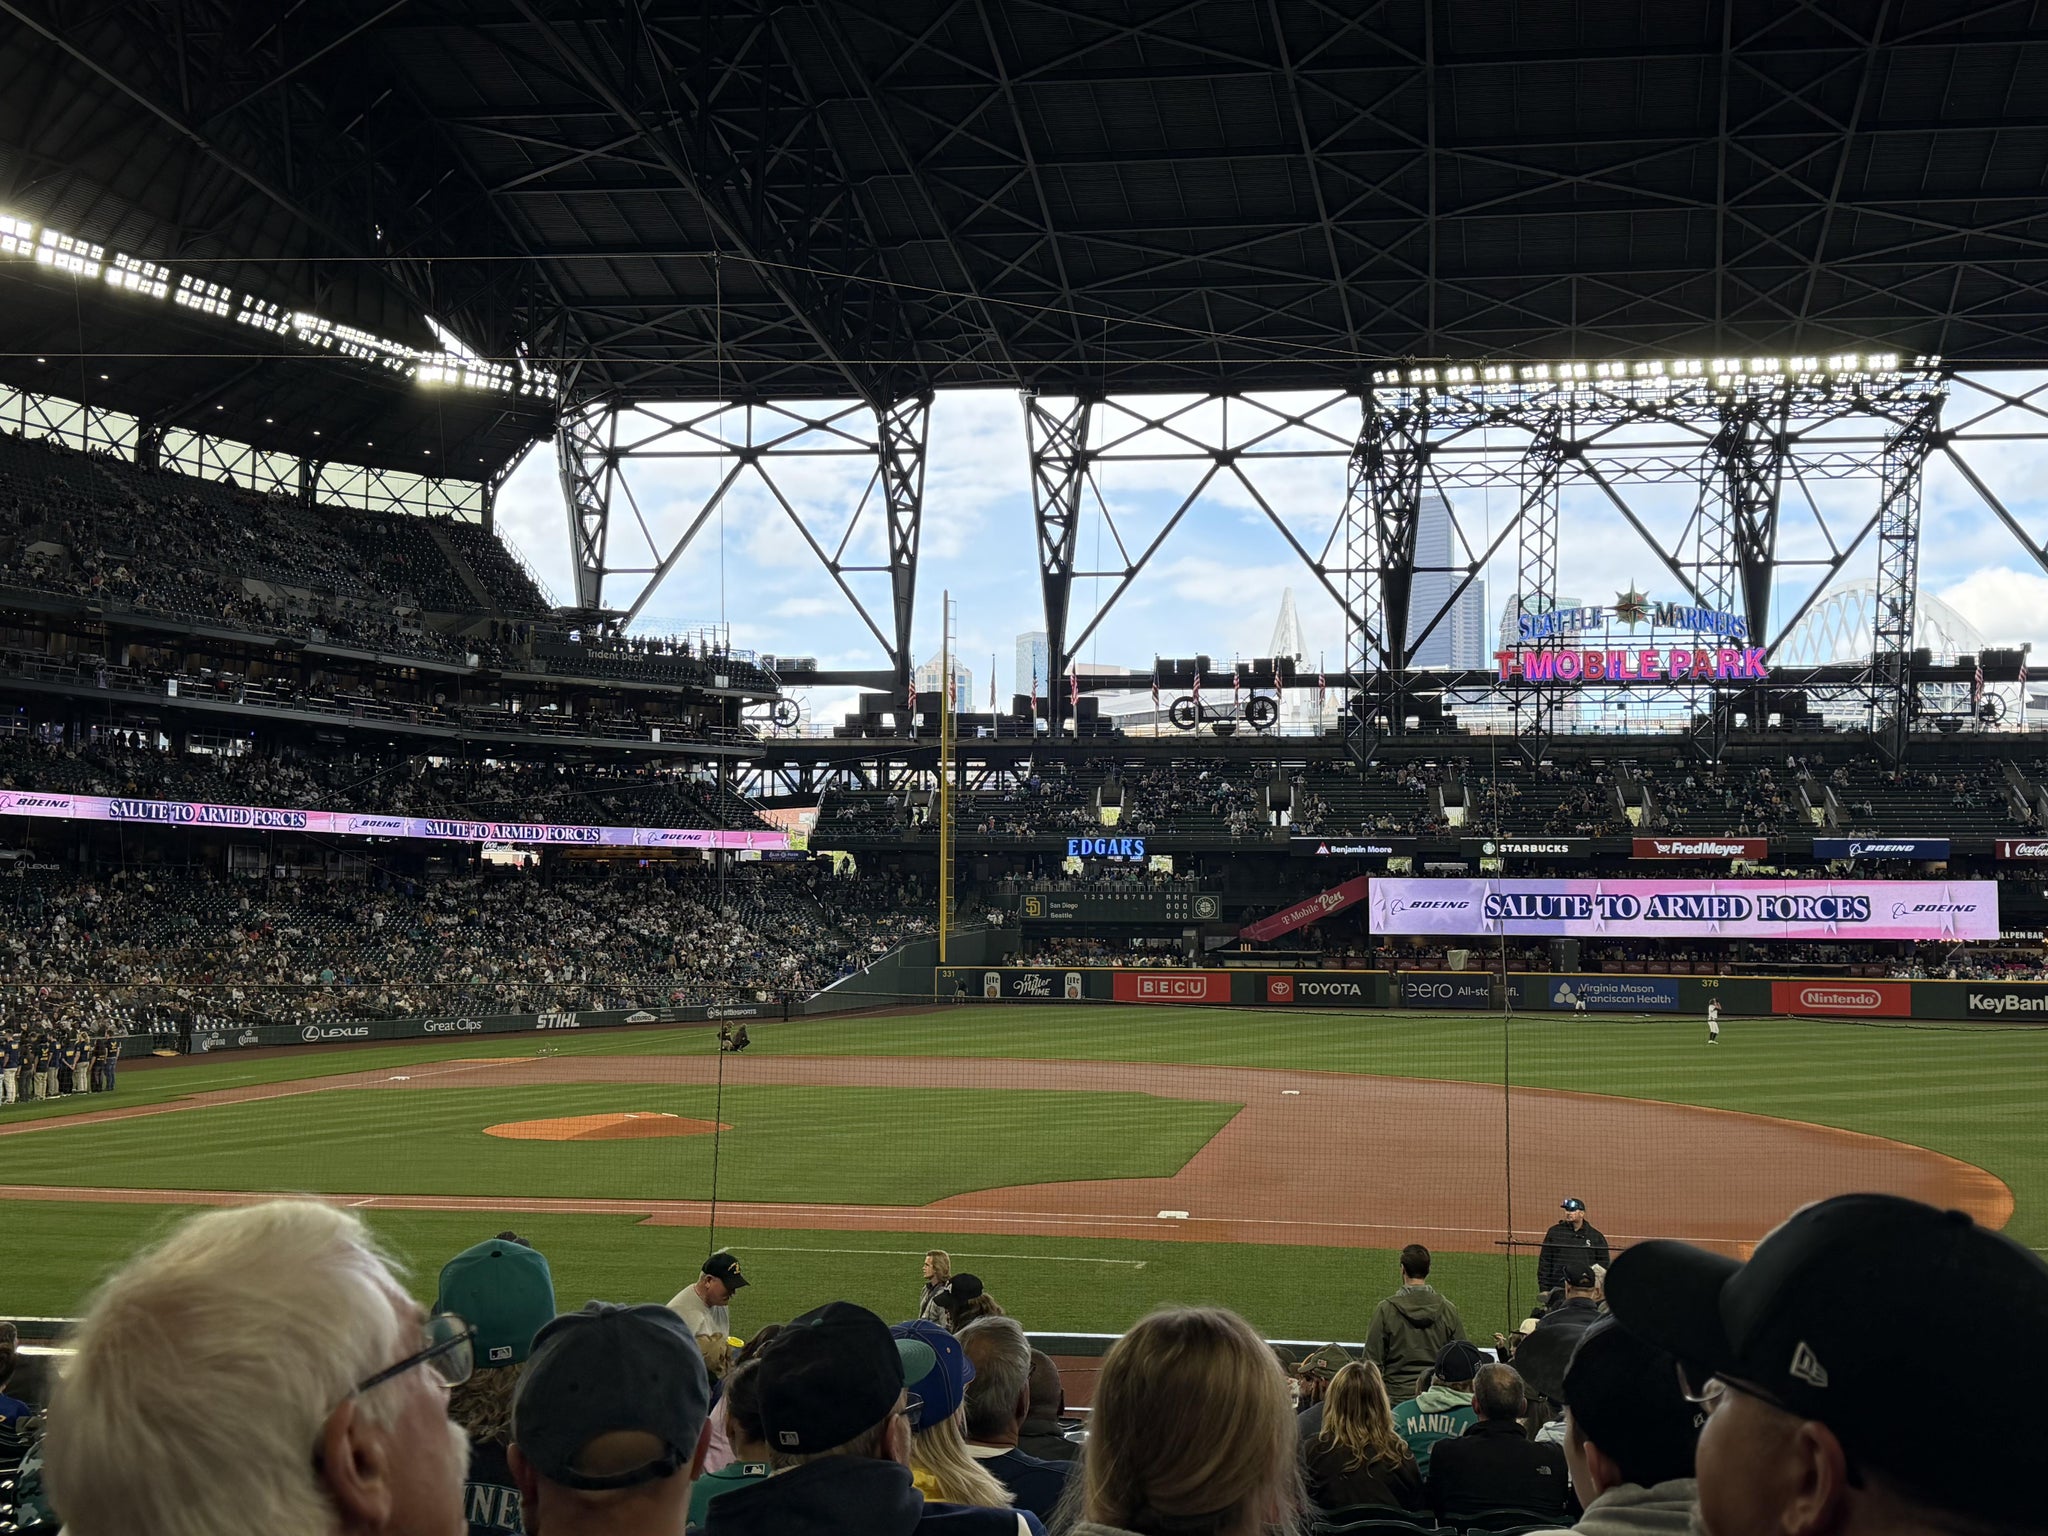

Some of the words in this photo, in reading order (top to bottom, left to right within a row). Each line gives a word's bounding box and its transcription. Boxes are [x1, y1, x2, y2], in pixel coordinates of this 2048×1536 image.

[1519, 605, 1603, 641] SEATTLE
[1653, 601, 1748, 638] MARINERS
[587, 649, 618, 660] Trident
[621, 652, 644, 661] Deck
[1494, 649, 1661, 681] T-MOBILE
[1669, 647, 1770, 681] PARK
[17, 798, 70, 808] BOEING
[110, 801, 168, 819] SALUTE
[172, 804, 195, 821] TO
[198, 806, 250, 824] ARMED
[253, 810, 306, 827] FORCES
[361, 820, 401, 828] BOEING
[426, 821, 470, 837] SALUTE
[472, 822, 489, 838] TO
[492, 824, 544, 840] ARMED
[547, 827, 599, 842] FORCES
[1330, 845, 1365, 855] Benjamin
[1367, 845, 1392, 854] Moore
[1500, 844, 1569, 853] STARBUCKS
[1865, 844, 1914, 852] BOEING
[1062, 902, 1078, 910] Diego
[1409, 901, 1470, 909] BOEING
[1486, 895, 1591, 918] SALUTE
[1597, 895, 1639, 918] TO
[1646, 896, 1750, 919] ARMED
[1759, 896, 1870, 920] FORCES
[1913, 904, 1977, 913] BOEING
[1290, 904, 1319, 922] Mobile
[2000, 931, 2026, 939] LLPEN
[2027, 931, 2045, 939] BAR
[942, 970, 955, 978] 331
[1013, 977, 1052, 996] Miller
[1299, 983, 1361, 995] TOYOTA
[1701, 979, 1719, 988] 376
[1580, 984, 1618, 995] Virginia
[1620, 984, 1655, 993] Mason
[1637, 994, 1672, 1004] Health
[1807, 991, 1875, 1005] Nintendo
[424, 1020, 455, 1032] Great
[456, 1018, 482, 1033] Clips
[536, 1013, 580, 1028] STIHL
[321, 1027, 369, 1038] LEXUS
[202, 1036, 225, 1050] Corona
